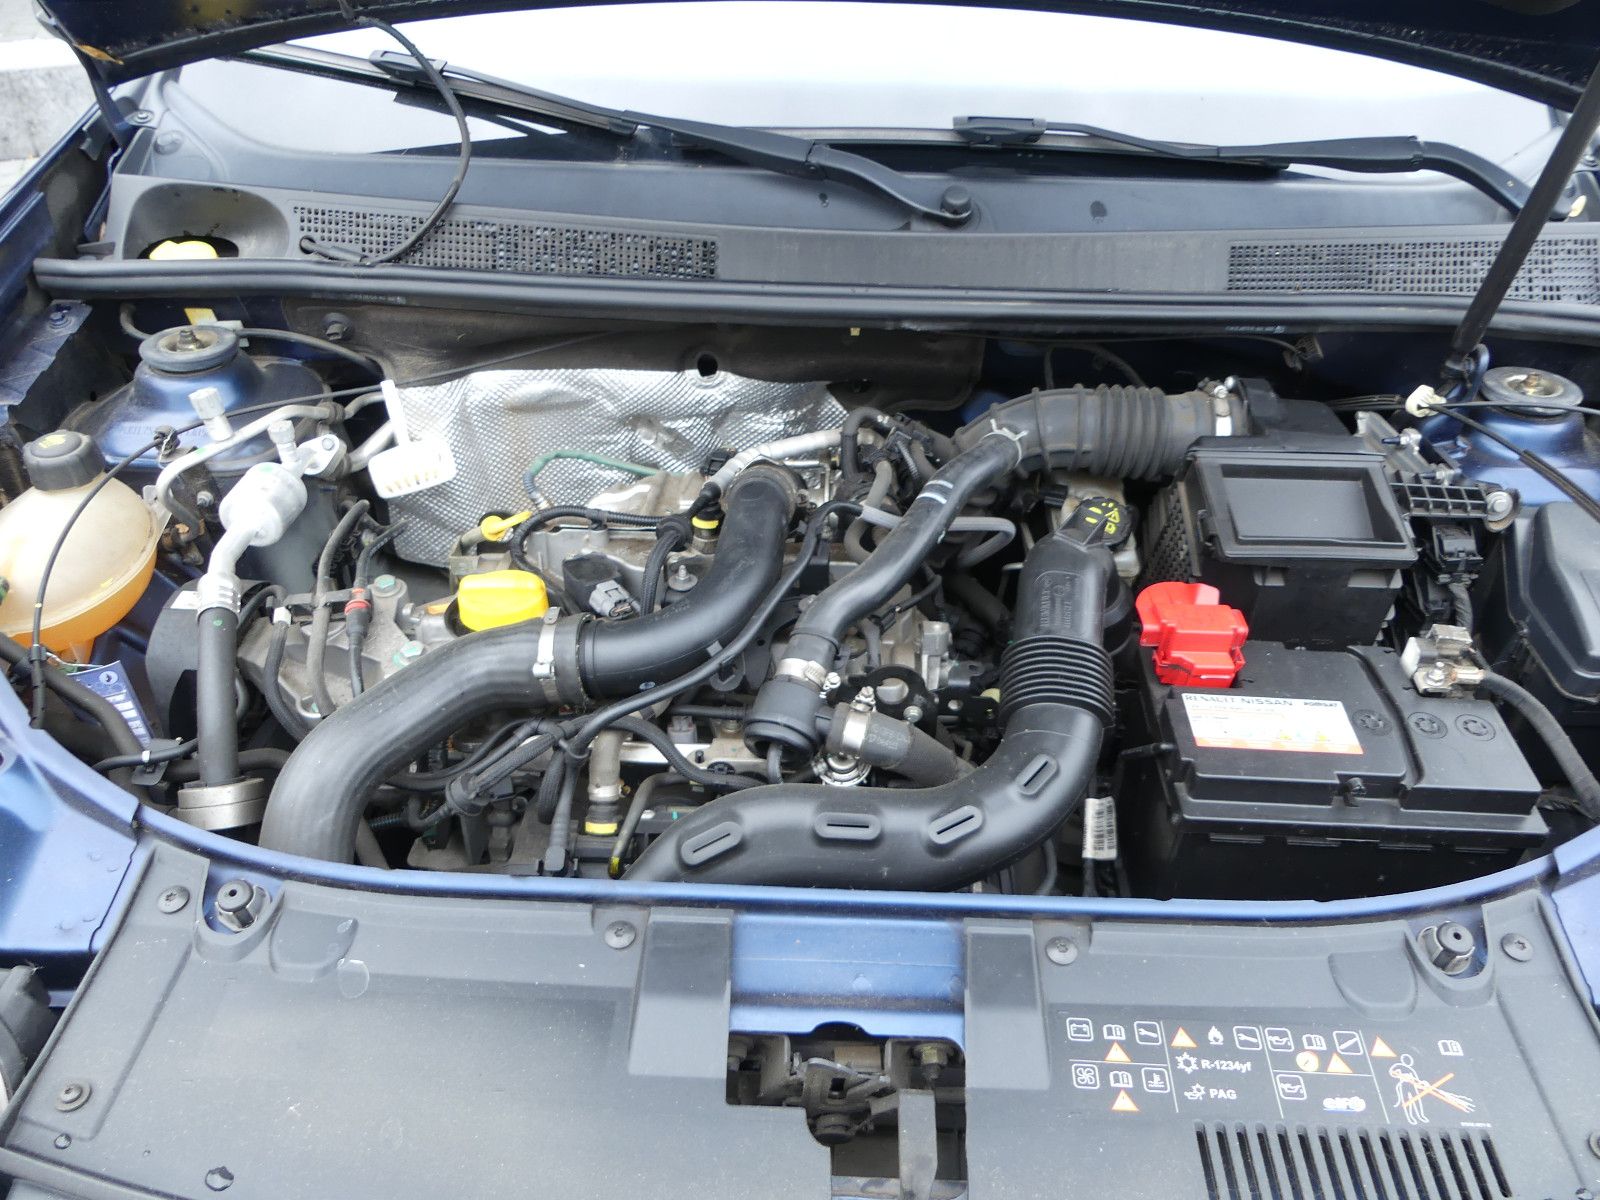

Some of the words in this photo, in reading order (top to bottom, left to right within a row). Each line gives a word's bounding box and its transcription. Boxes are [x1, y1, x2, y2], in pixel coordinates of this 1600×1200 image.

[1240, 696, 1294, 706] NISSAN
[1201, 1058, 1252, 1073] R-1234yf
[1209, 1088, 1237, 1100] PAG
